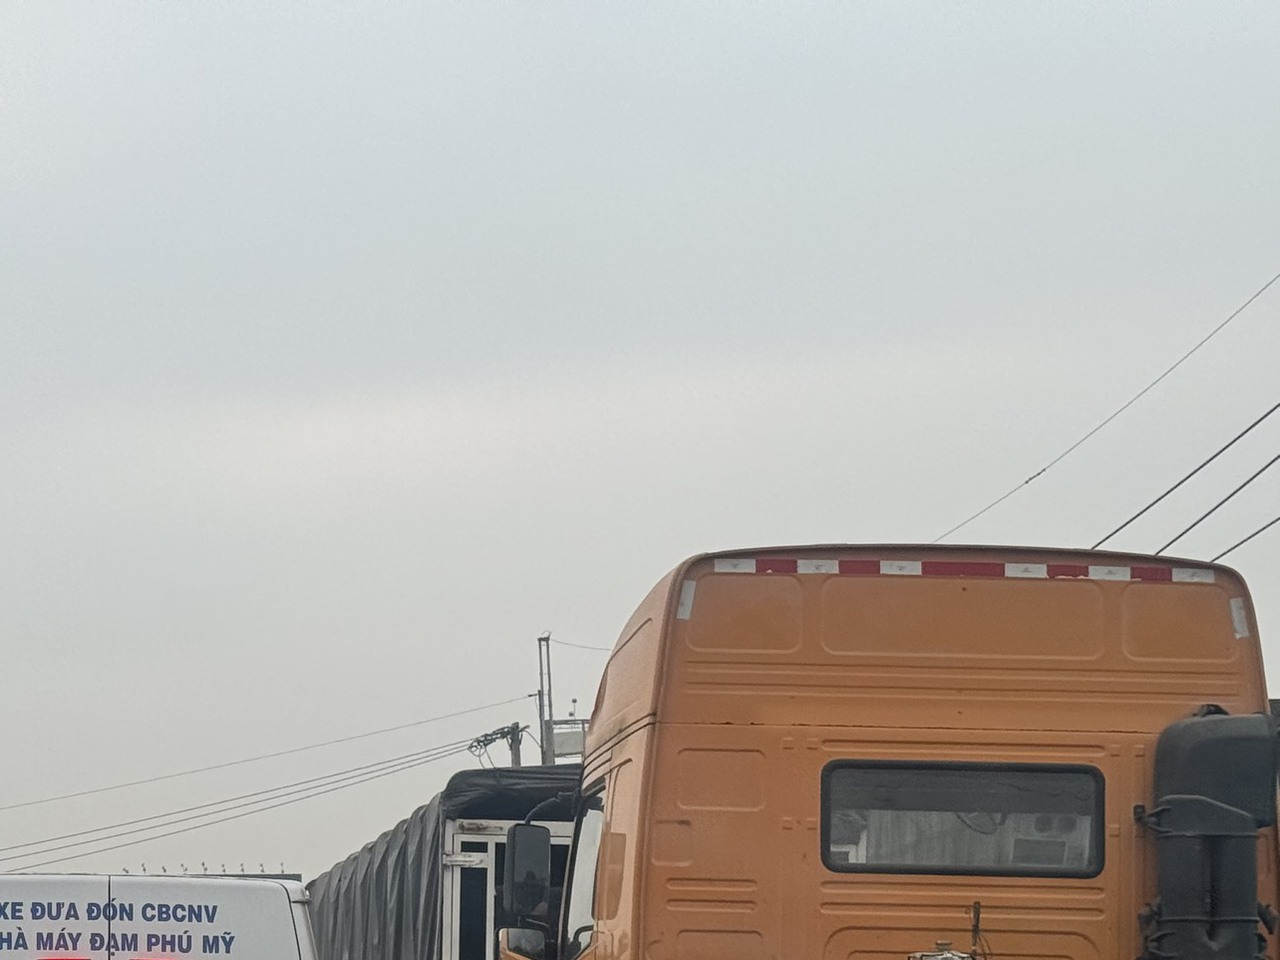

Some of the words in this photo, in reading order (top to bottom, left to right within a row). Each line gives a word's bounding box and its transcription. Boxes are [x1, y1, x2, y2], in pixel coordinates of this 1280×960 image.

[30, 901, 80, 921] ĐƯA
[86, 898, 134, 922] ĐÓN
[141, 903, 218, 923] CBCNV
[36, 927, 82, 951] MÁY
[89, 932, 138, 956] ĐẠM
[147, 930, 193, 954] PHÚ
[202, 931, 236, 954] MỸ
